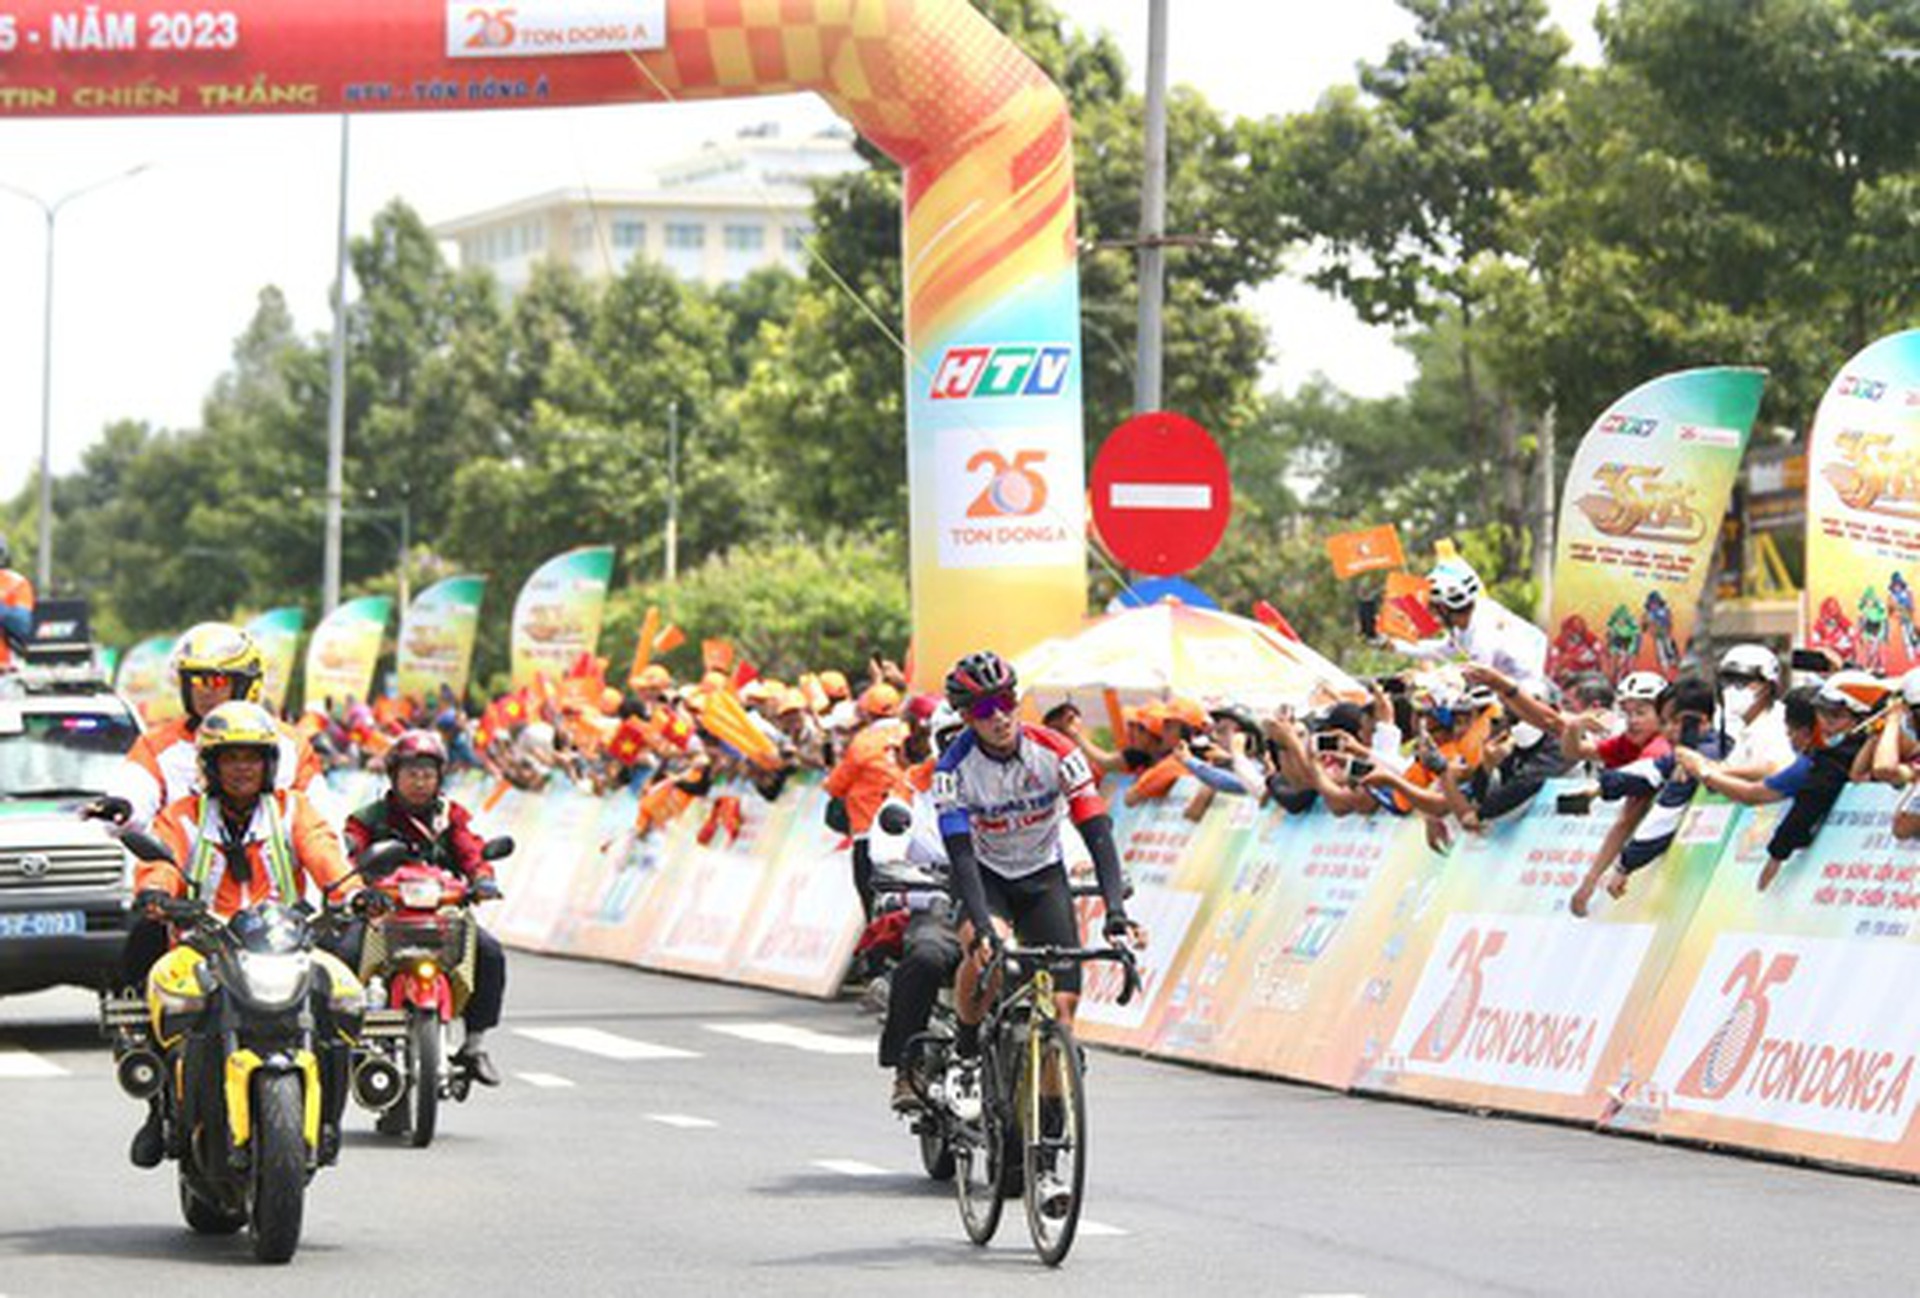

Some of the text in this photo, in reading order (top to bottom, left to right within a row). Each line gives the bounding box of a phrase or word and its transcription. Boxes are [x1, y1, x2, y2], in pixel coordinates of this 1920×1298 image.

[51, 5, 137, 49] NĂM
[148, 11, 239, 49] 2023
[464, 9, 519, 48] 25
[520, 22, 648, 45] TON DONG A
[0, 72, 319, 107] TIN CHIẾN THẮNG
[930, 347, 1071, 399] HTV
[966, 448, 1048, 518] 25
[950, 525, 1067, 546] TON DONG A
[1674, 948, 1800, 1100] 25
[1747, 1038, 1916, 1116] TON DONG A
